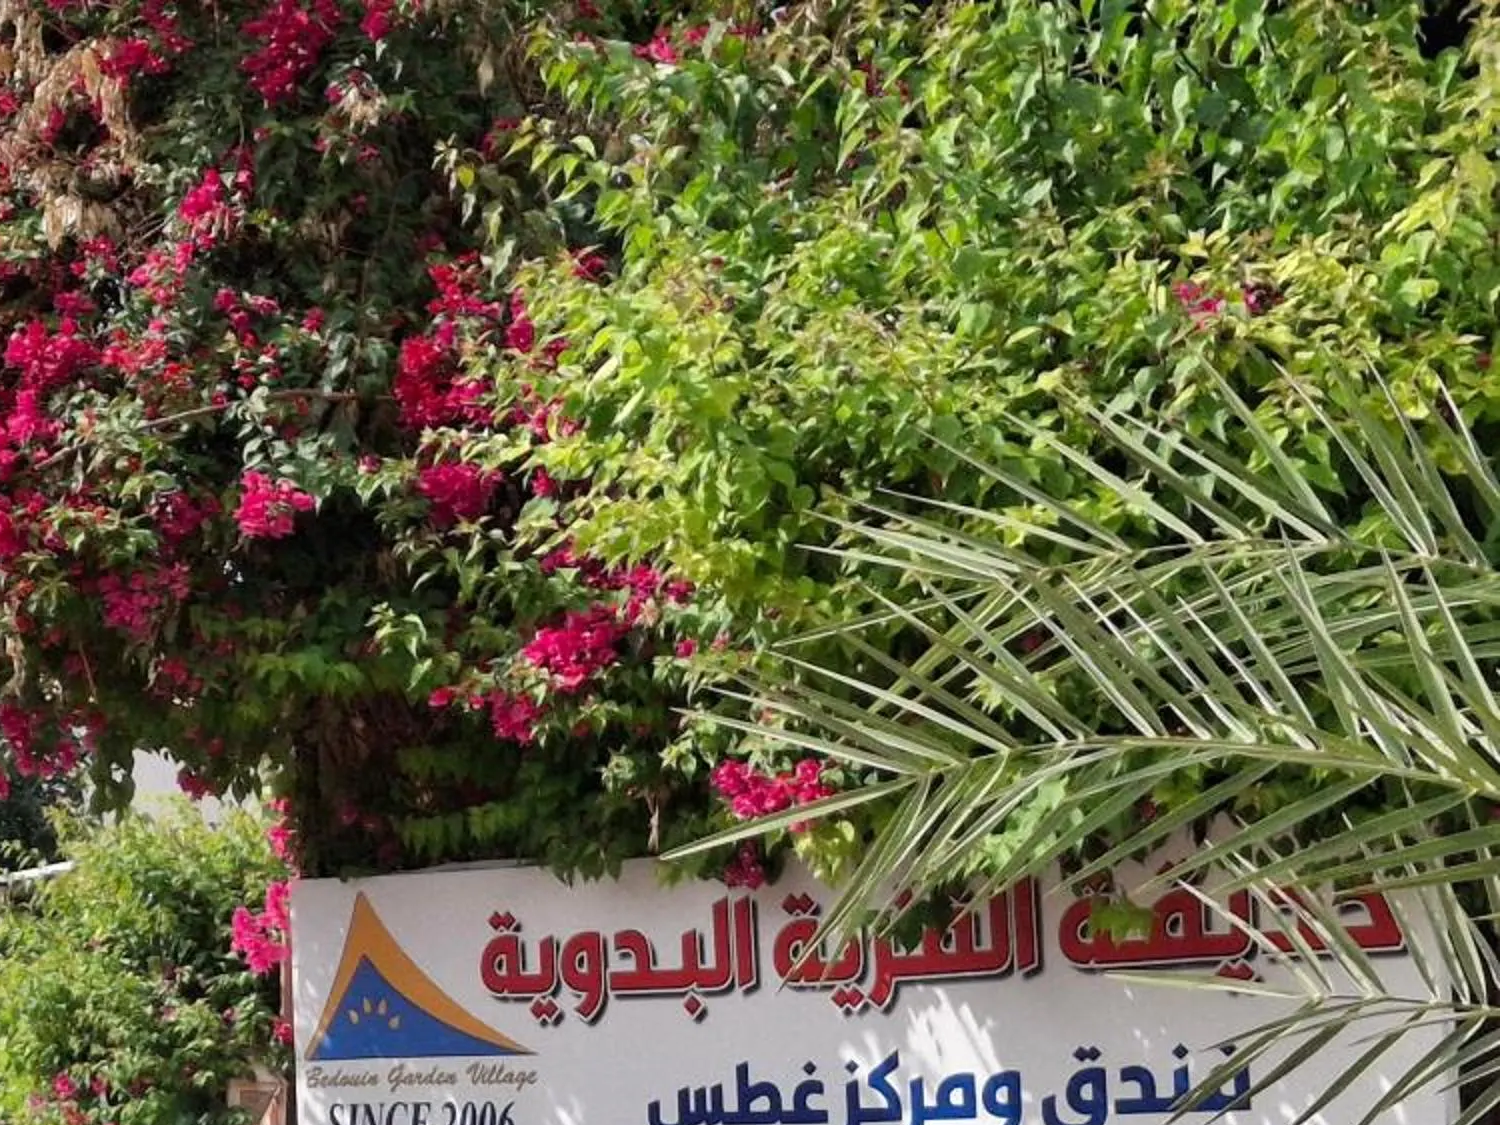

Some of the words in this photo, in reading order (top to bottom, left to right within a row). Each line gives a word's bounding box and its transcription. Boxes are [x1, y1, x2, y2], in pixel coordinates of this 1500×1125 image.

[479, 893, 758, 1018] البدوية
[306, 1066, 380, 1089] Bedouin
[387, 1063, 459, 1093] Garden
[465, 1060, 538, 1092] Village
